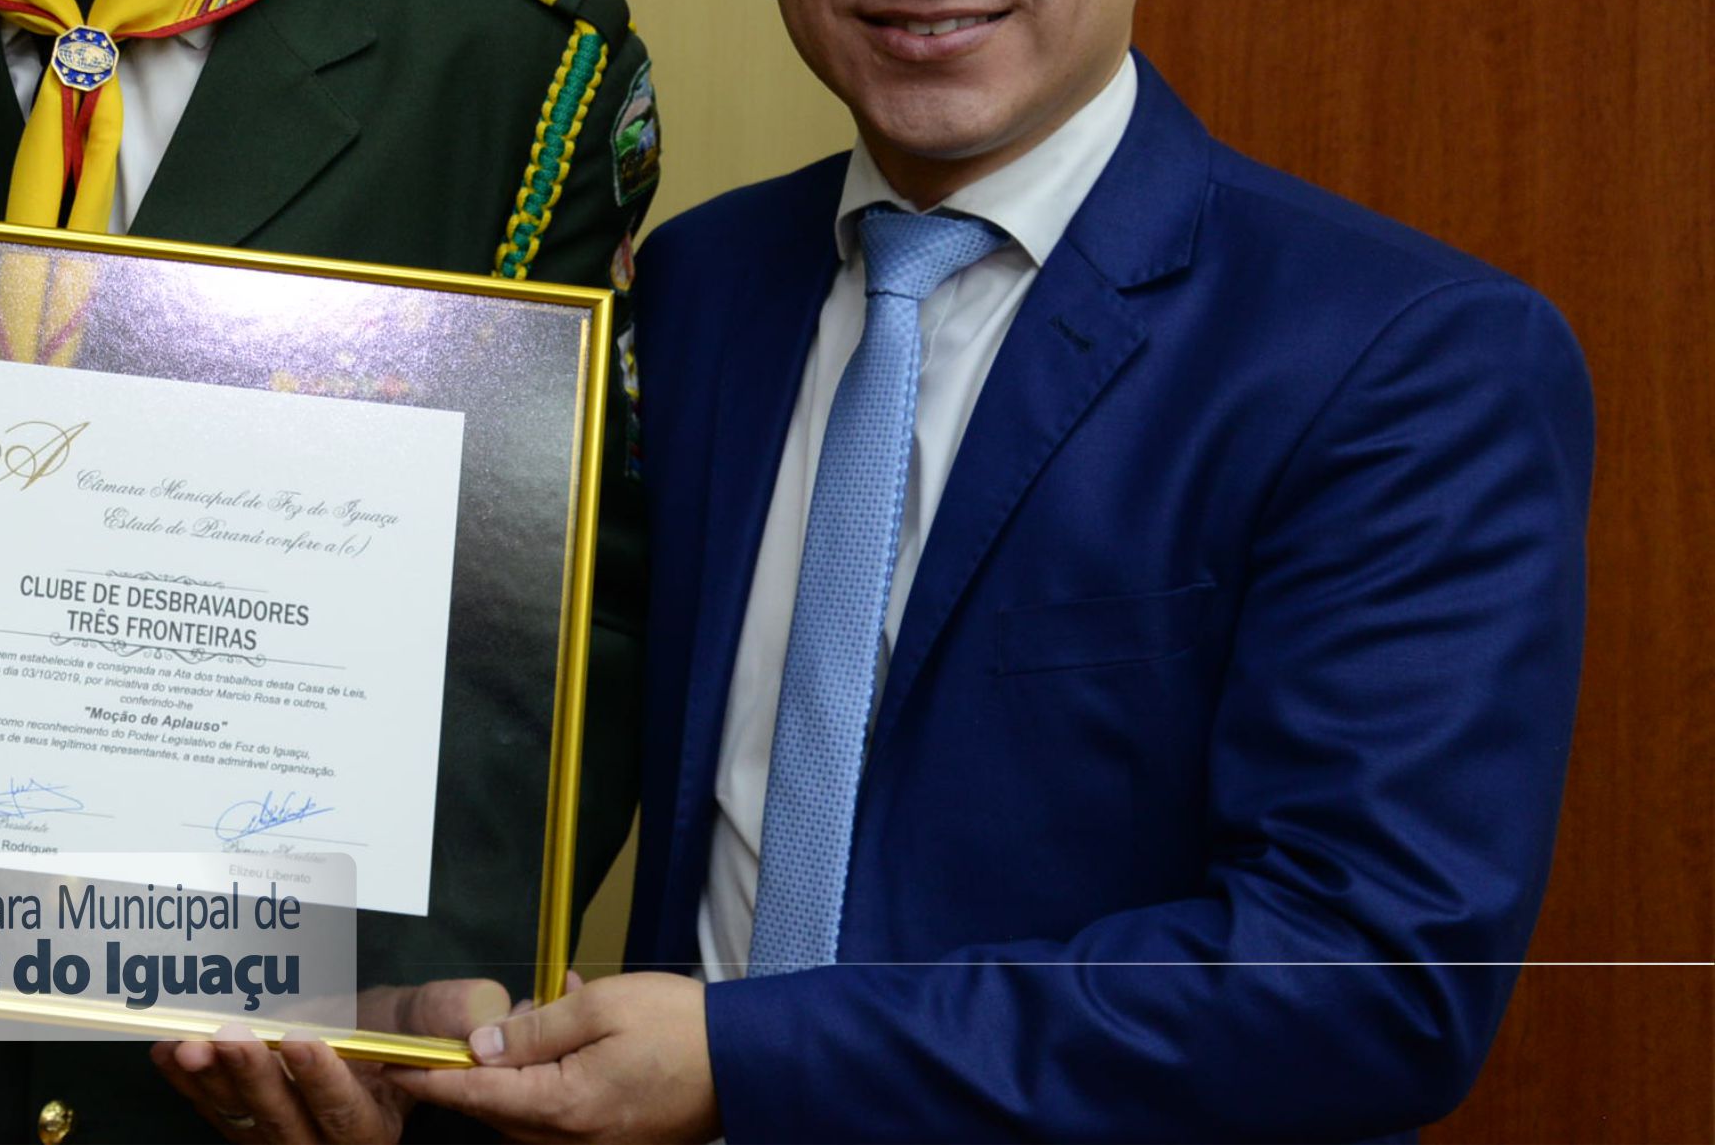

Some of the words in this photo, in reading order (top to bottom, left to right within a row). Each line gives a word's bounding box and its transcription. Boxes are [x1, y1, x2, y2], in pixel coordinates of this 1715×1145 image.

[76, 469, 146, 497] Câmara
[150, 477, 242, 510] Municipal
[242, 491, 263, 510] de
[268, 490, 303, 521] Foz
[307, 498, 329, 516] do
[332, 498, 399, 528] Iguaçu
[103, 507, 162, 532] Estado
[190, 516, 263, 546] Paraná
[265, 529, 321, 555] confere
[20, 575, 86, 602] CLUBE
[93, 583, 121, 605] DE
[127, 586, 310, 626] DESBRAVADORES
[67, 608, 119, 636] TRÊS
[126, 617, 257, 651] FRONTEIRAS
[3, 665, 19, 677] dia
[22, 667, 82, 684] 03/10/2019,
[85, 676, 102, 687] por
[105, 675, 149, 691] iniciativa
[152, 682, 165, 692] do
[168, 684, 213, 697] vereador
[216, 688, 251, 702] Marcio
[253, 692, 281, 705] Rosa
[283, 698, 291, 706] e
[293, 699, 328, 712] outros,
[20, 653, 84, 668] estabelecida
[87, 661, 94, 669] e
[96, 661, 155, 676] consignada
[158, 668, 171, 677] na
[174, 669, 191, 679] Ata
[194, 671, 213, 682] dos
[216, 673, 263, 688] trabalhos
[266, 678, 294, 691] desta
[298, 682, 324, 694] Casa
[327, 685, 340, 696] de
[343, 687, 368, 700] Leis,
[85, 706, 136, 724] "Moção
[141, 712, 158, 726] de
[162, 715, 228, 733] Aplauso"
[120, 694, 194, 711] conferindo-lhe
[7, 733, 21, 743] de
[24, 735, 48, 746] seus
[51, 737, 97, 752] legítimos
[100, 743, 180, 761] representantes,
[183, 753, 190, 761] a
[193, 753, 215, 764] esta
[218, 755, 269, 770] admirável
[270, 760, 337, 778] organização.
[27, 720, 109, 738] reconhecimento
[112, 728, 125, 739] do
[128, 729, 159, 743] Poder
[161, 733, 216, 749] Legislativo
[219, 740, 233, 750] de
[235, 742, 254, 753] Foz
[257, 744, 270, 755] do
[273, 746, 310, 761] Iguaçu,
